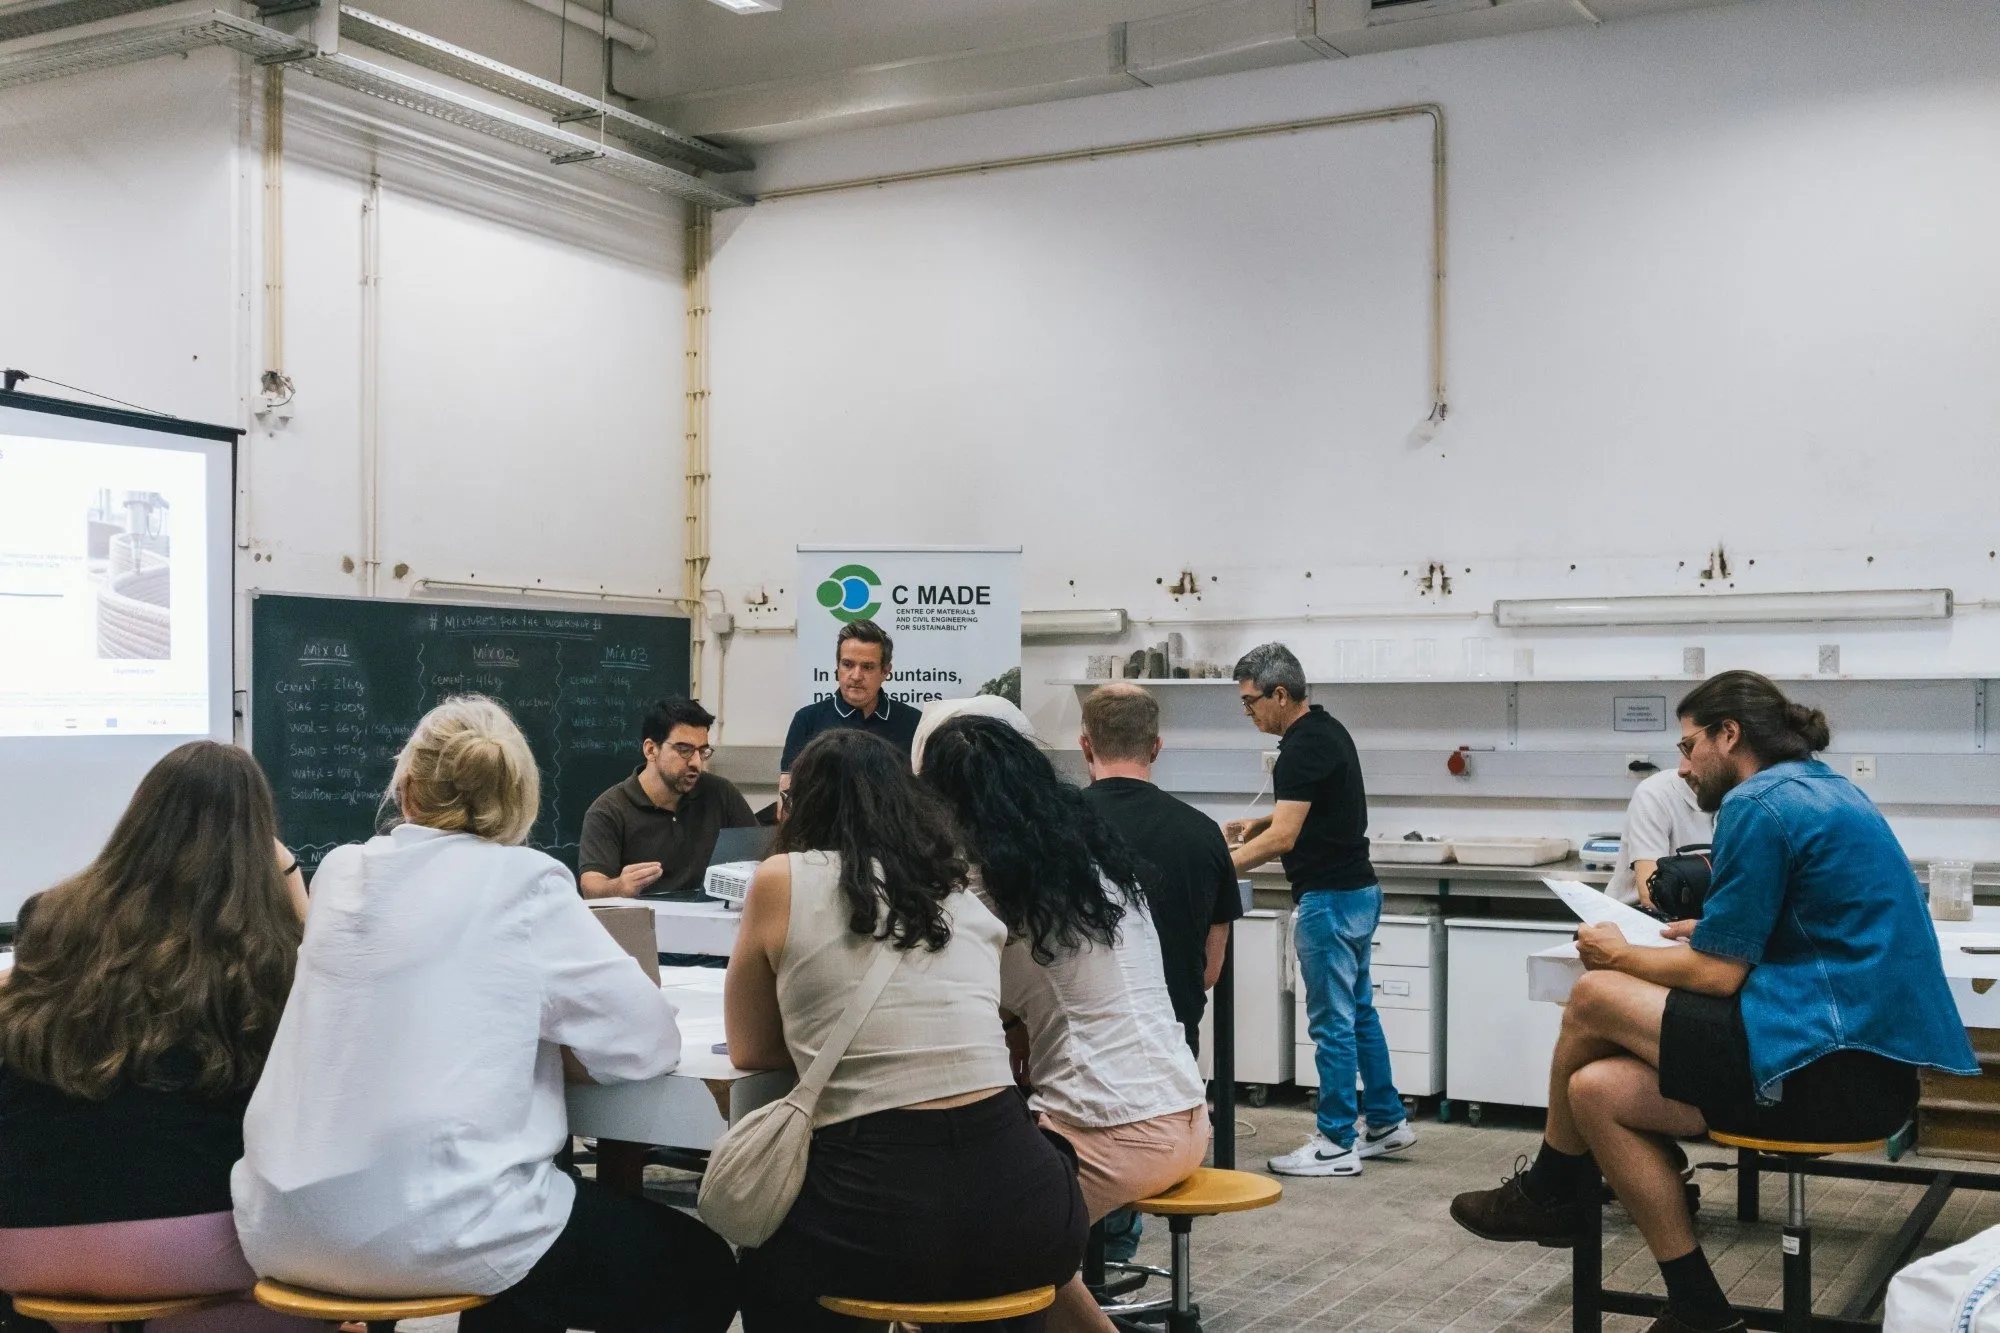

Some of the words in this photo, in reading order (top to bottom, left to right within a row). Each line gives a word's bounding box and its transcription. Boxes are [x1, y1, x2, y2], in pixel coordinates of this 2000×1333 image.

[892, 585, 908, 605] C
[917, 586, 990, 605] MADE
[896, 608, 924, 616] CENTRE
[925, 608, 935, 616] OF
[936, 608, 976, 616] MATERIALS
[931, 616, 978, 624] ENGINEERING
[813, 667, 829, 682] In
[885, 668, 962, 685] ountains,
